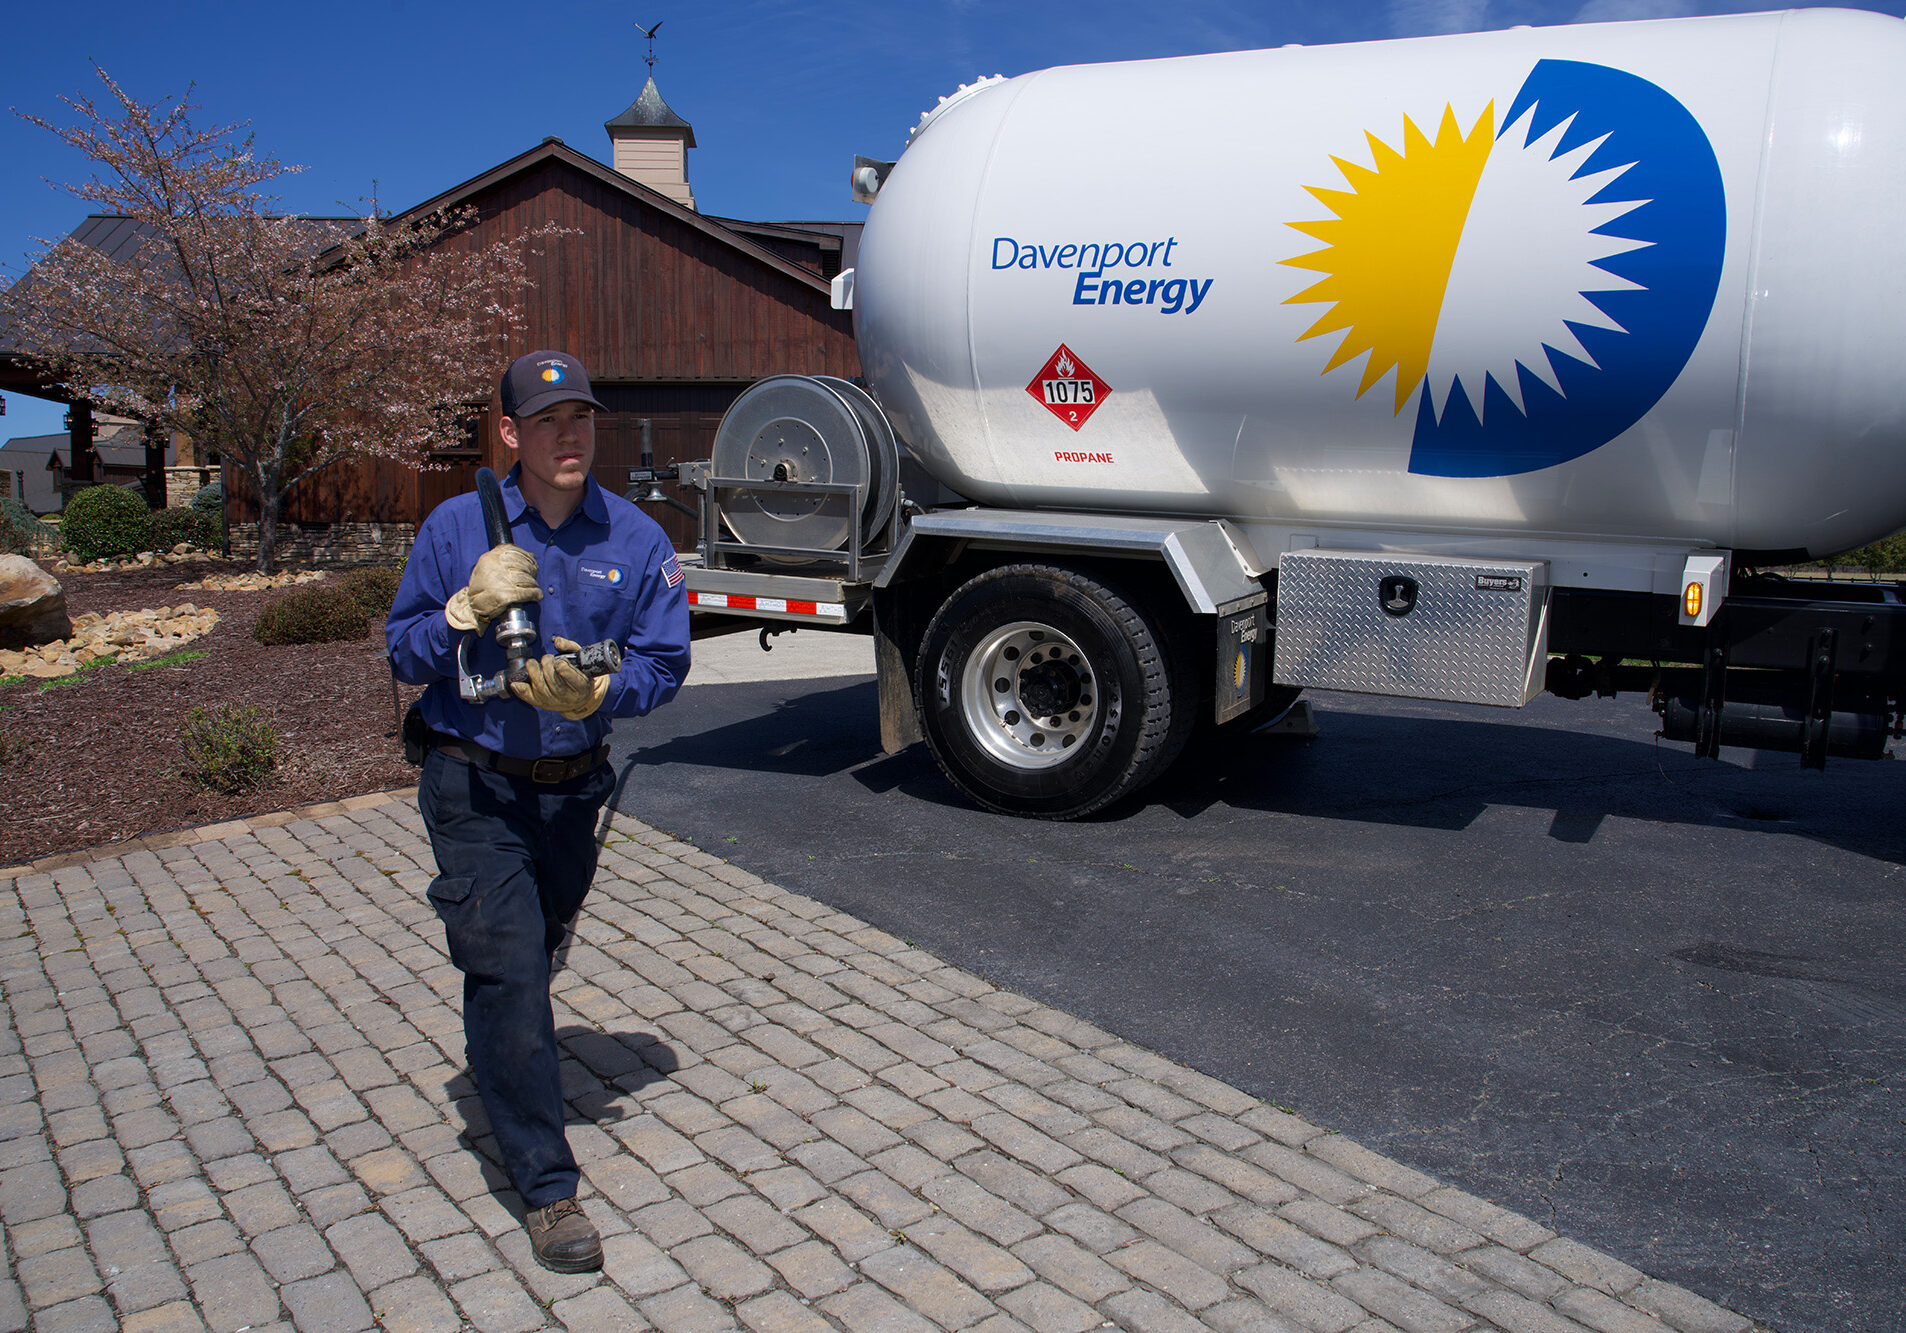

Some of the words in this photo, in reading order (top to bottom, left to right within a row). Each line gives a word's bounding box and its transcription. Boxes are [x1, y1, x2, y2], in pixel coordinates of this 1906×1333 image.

[992, 237, 1178, 276] Davenport
[1072, 271, 1214, 315] Energy
[1046, 381, 1093, 403] 1075
[1069, 411, 1078, 422] 2
[1054, 451, 1114, 463] PROPANE
[1478, 576, 1507, 587] Buyers
[1231, 613, 1255, 634] Davenport
